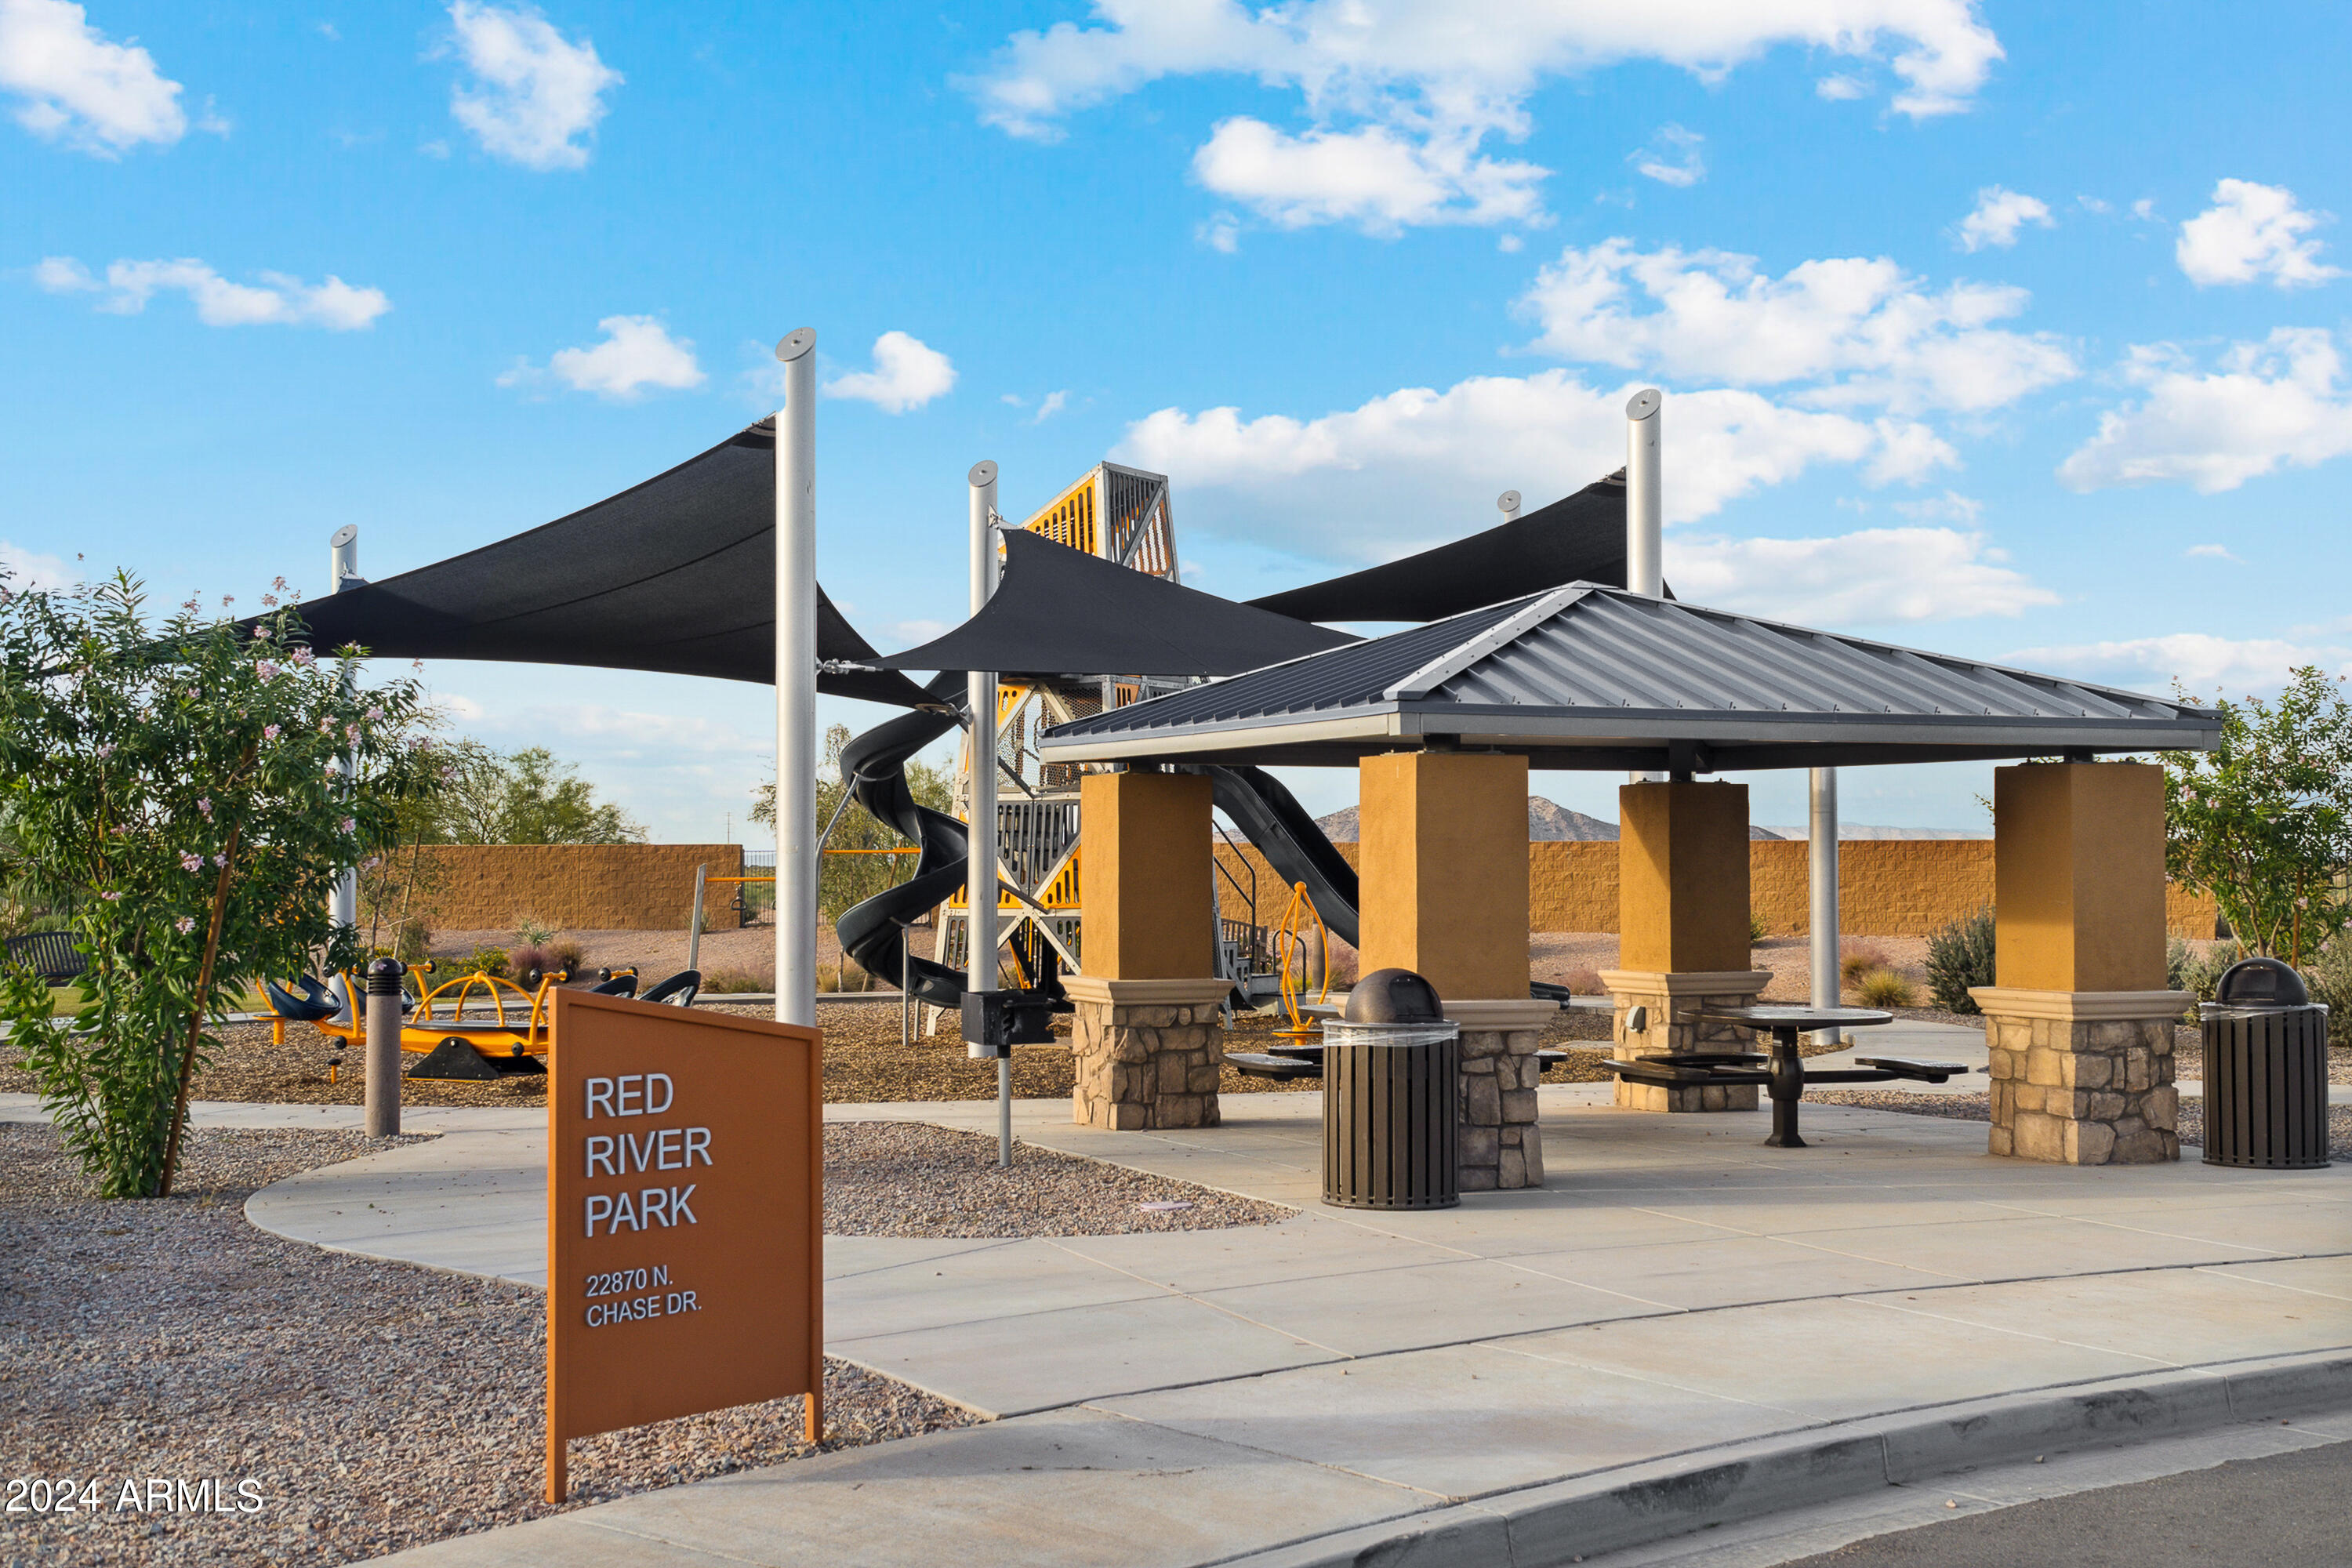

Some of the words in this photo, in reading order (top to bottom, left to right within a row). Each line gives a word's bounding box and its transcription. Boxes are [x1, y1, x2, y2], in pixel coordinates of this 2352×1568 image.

[586, 1073, 674, 1119] RED
[586, 1127, 713, 1178] RIVER
[586, 1184, 698, 1237] PARK
[586, 1269, 647, 1298] 22870
[652, 1265, 673, 1287] N.
[586, 1295, 660, 1327] CHASE
[666, 1290, 702, 1315] DR.
